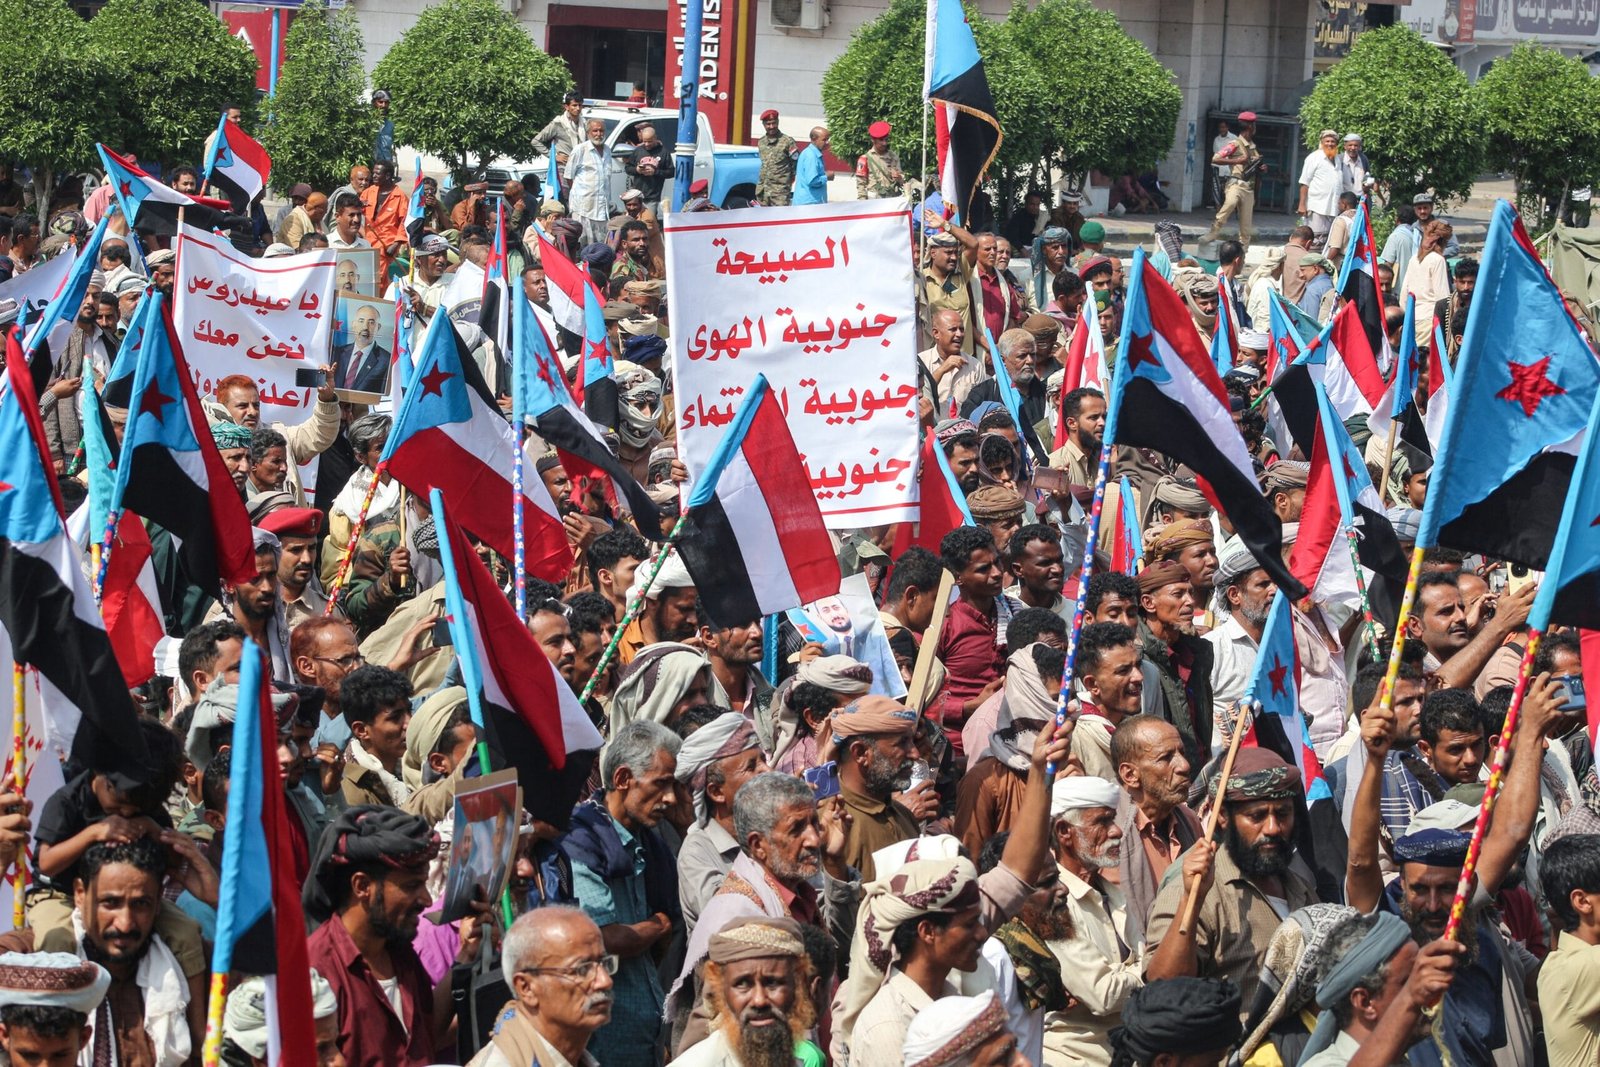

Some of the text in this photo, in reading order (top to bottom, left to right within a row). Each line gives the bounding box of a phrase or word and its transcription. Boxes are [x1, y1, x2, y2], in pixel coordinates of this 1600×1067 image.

[698, 25, 720, 100] ADEN
[712, 235, 850, 285] الصبيحة
[188, 275, 323, 319] يا عيدروس
[193, 319, 305, 361] نحن معك
[687, 303, 898, 362] جنوبية الهوى
[680, 373, 918, 431] جنوبية اتماء
[800, 448, 912, 501] جنوبي
